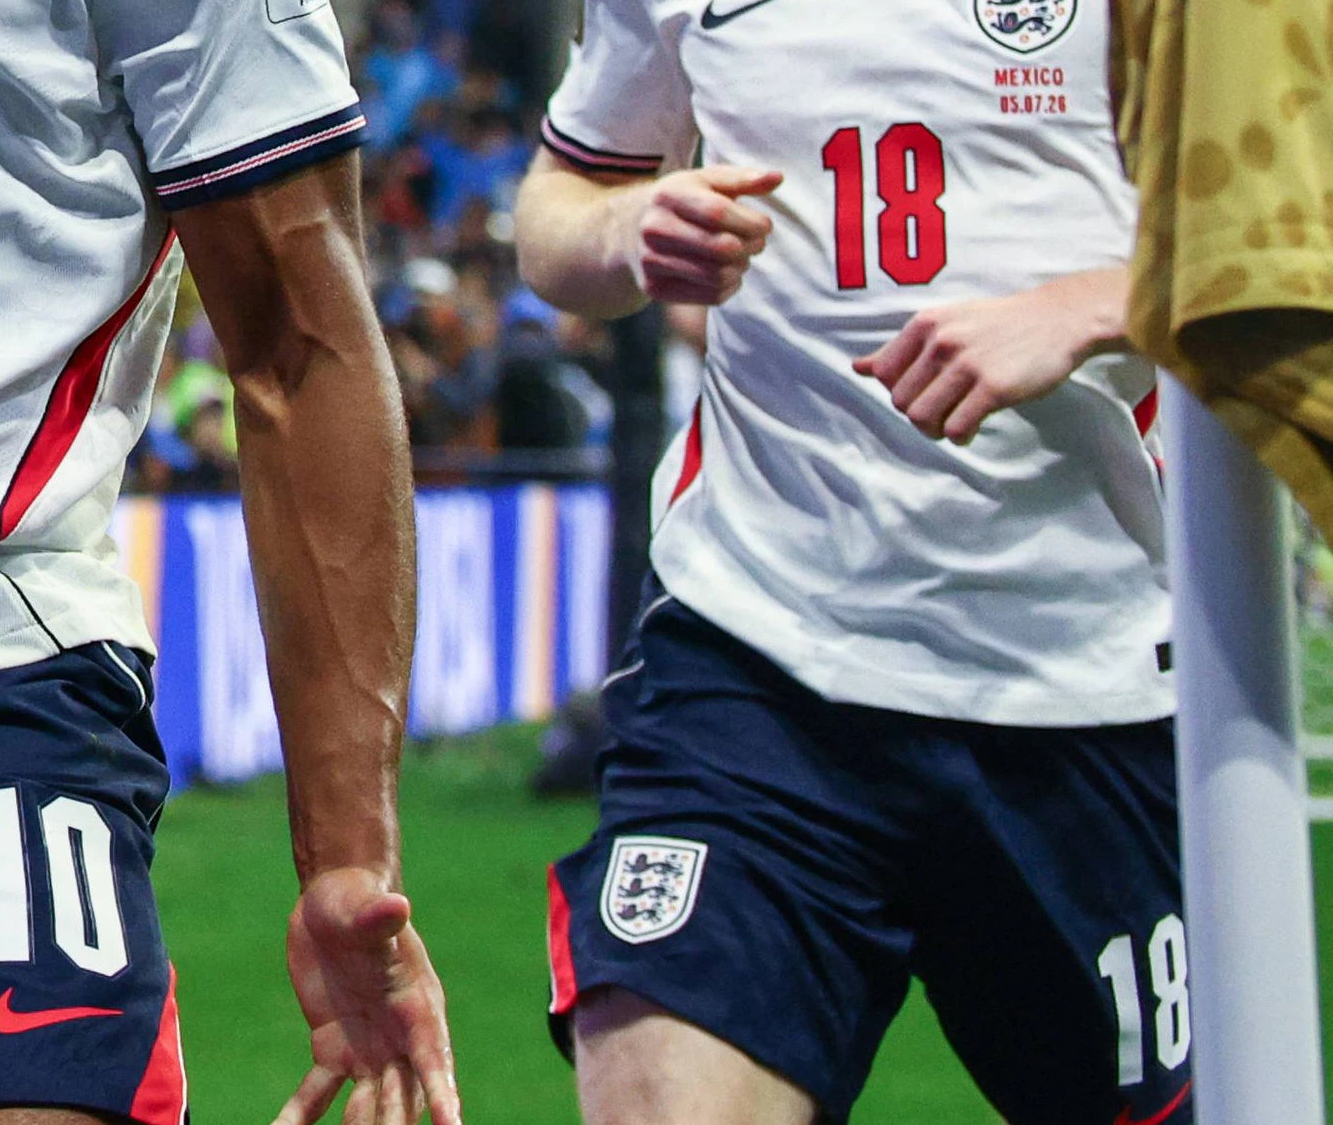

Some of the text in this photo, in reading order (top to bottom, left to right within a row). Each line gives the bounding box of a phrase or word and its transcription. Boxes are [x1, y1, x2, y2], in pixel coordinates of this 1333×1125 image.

[994, 66, 1065, 87] MEXICO
[821, 121, 948, 291] 18
[1097, 912, 1192, 1087] 18
